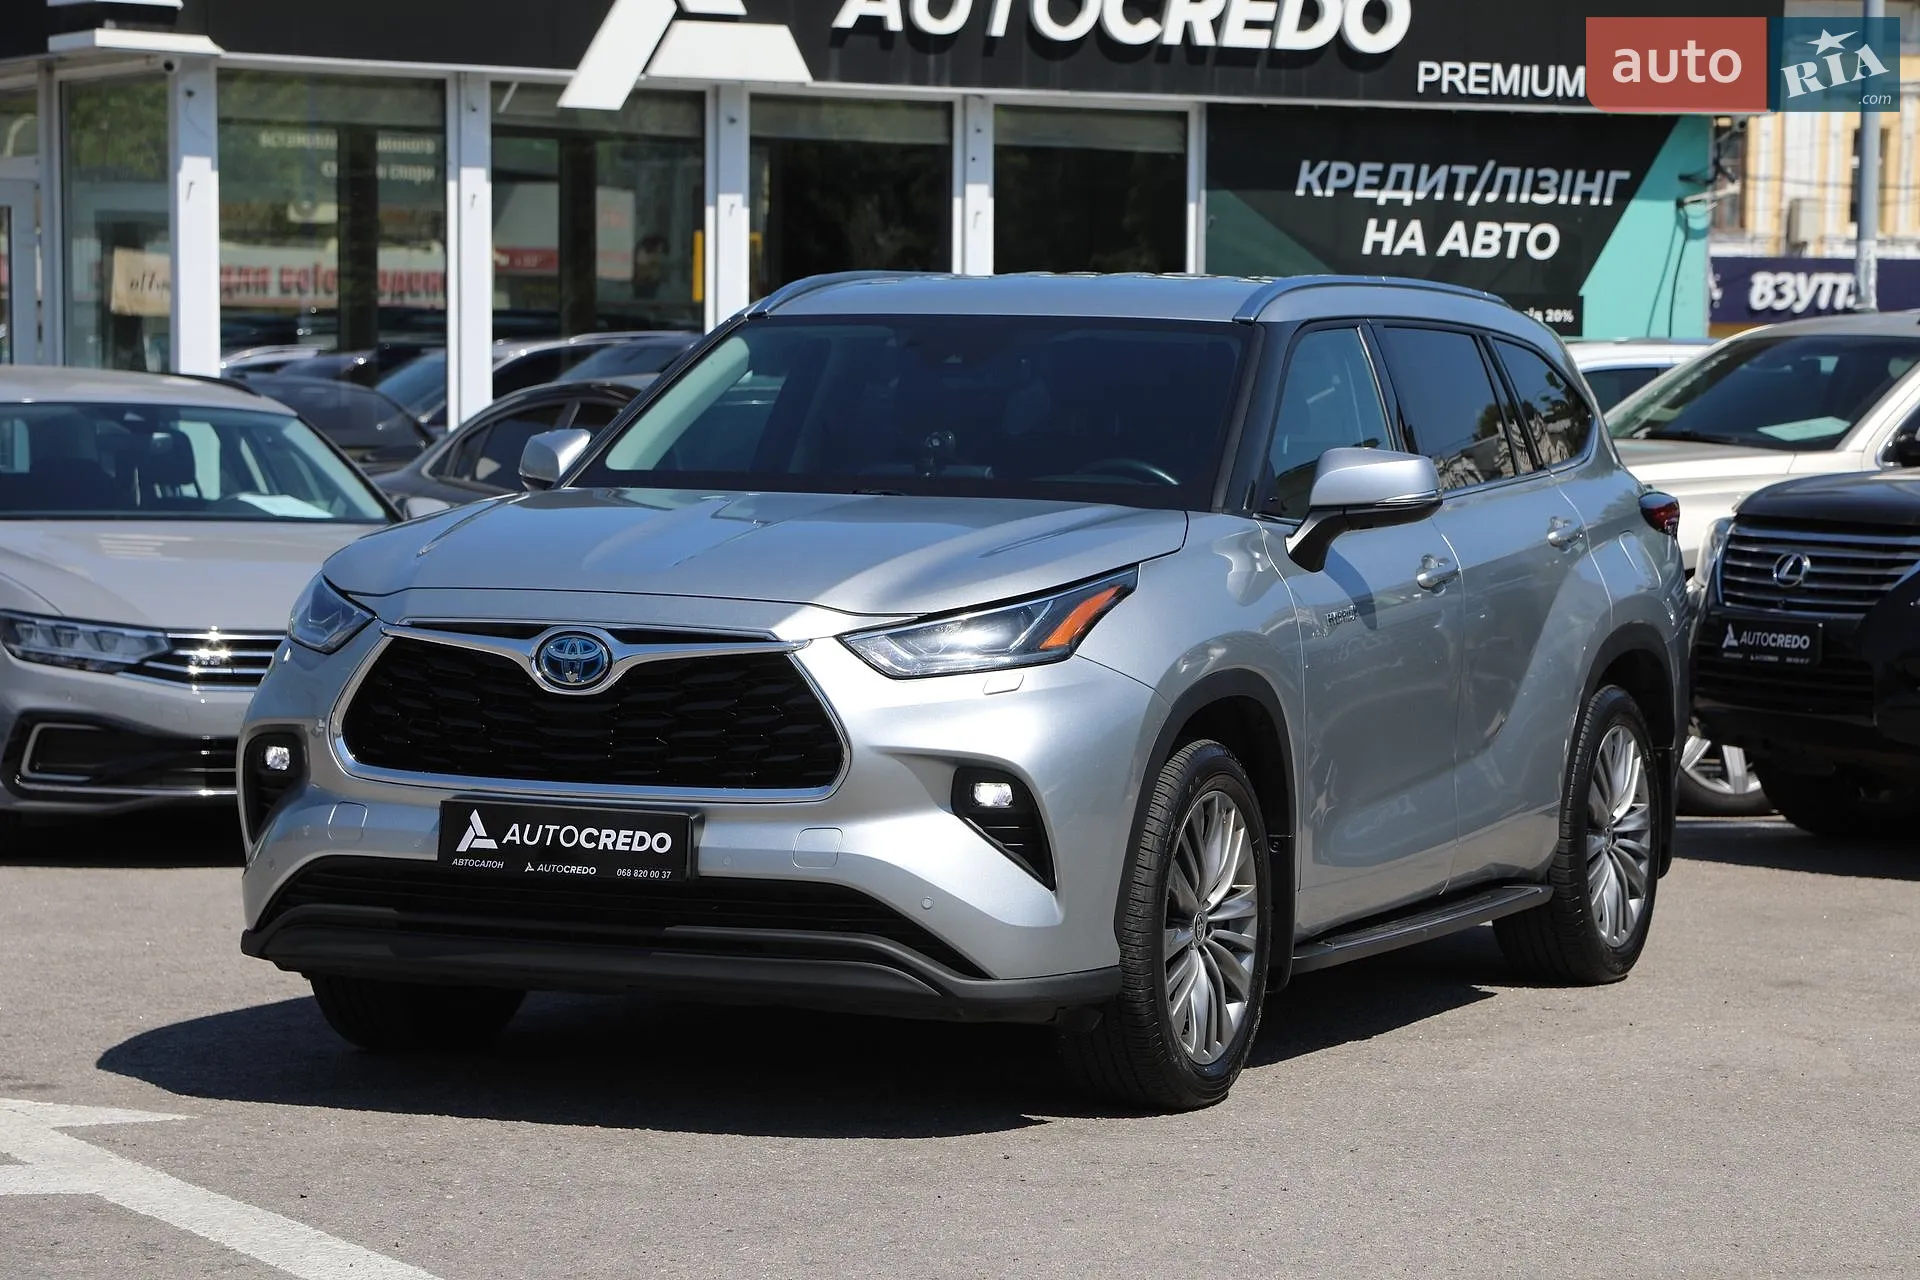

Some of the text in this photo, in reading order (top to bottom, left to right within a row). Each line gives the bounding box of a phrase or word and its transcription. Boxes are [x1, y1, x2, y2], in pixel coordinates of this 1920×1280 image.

[1416, 60, 1587, 98] PREMIUM
[1294, 159, 1631, 206] КРЕДИТ/ЛІЗІНГ
[1361, 218, 1560, 260] НА АВТО
[1545, 308, 1574, 323] 20%
[1740, 631, 1810, 650] AUTOCREDO
[501, 823, 672, 854] AUTOCREDO
[452, 858, 504, 869] АВТОСАЛОН
[537, 864, 597, 875] AUTOCREDO
[616, 868, 671, 879] 068 820 00 37
